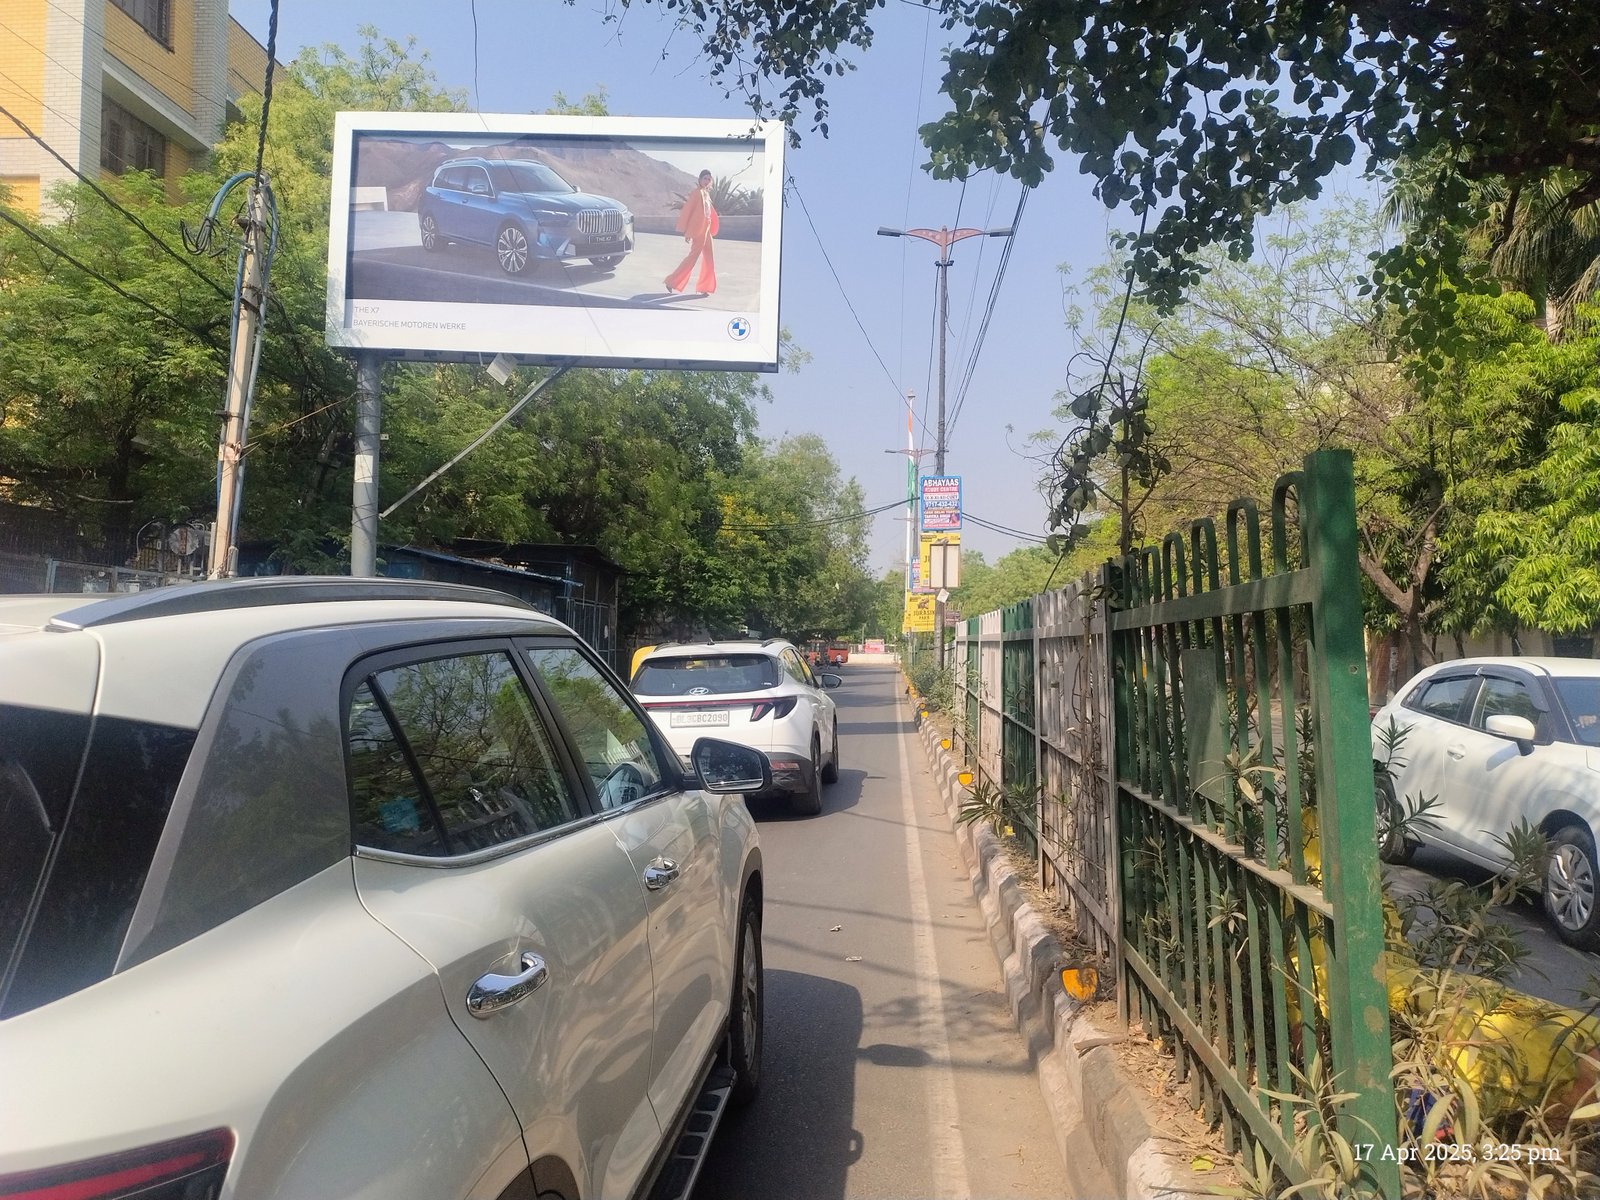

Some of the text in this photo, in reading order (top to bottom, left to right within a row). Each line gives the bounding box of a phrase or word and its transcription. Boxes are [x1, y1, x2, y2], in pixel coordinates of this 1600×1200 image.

[354, 306, 380, 314] THE X7
[353, 319, 466, 330] BAYERISCHE MOTOREN WERKE
[923, 478, 959, 487] ABHAYAAS
